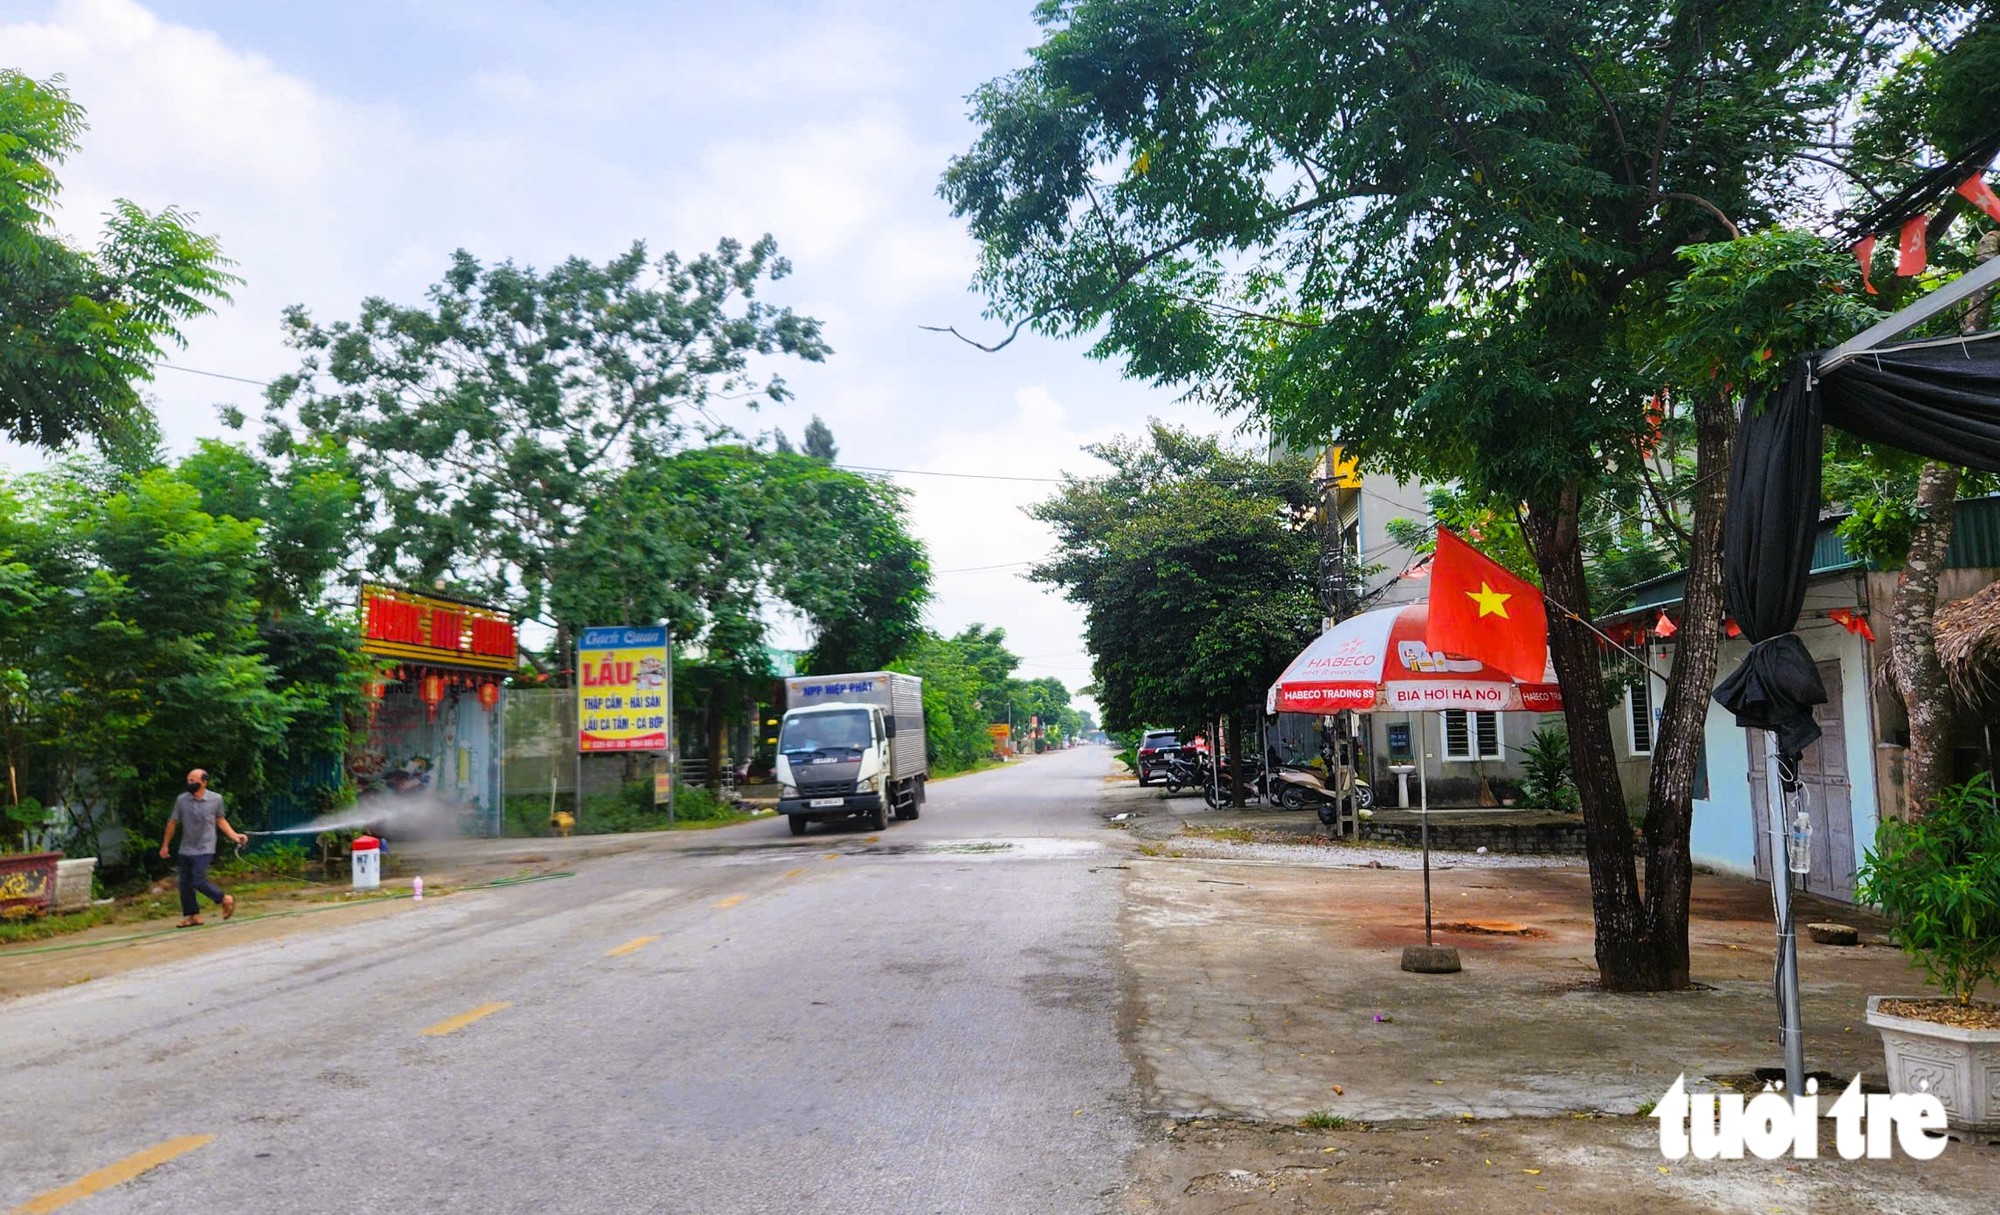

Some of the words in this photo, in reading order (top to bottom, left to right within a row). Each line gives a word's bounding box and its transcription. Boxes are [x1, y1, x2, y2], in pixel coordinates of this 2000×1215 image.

[1307, 655, 1376, 668] HABECO
[583, 651, 633, 686] LẨU
[803, 686, 822, 696] NPP
[1284, 690, 1321, 700] HABECO
[1322, 690, 1362, 698] TRADING
[1363, 689, 1375, 698] 89
[1397, 691, 1420, 701] BIA
[1424, 688, 1449, 700] HƠI
[1453, 687, 1472, 700] HÀ
[1476, 687, 1502, 703] NỘI
